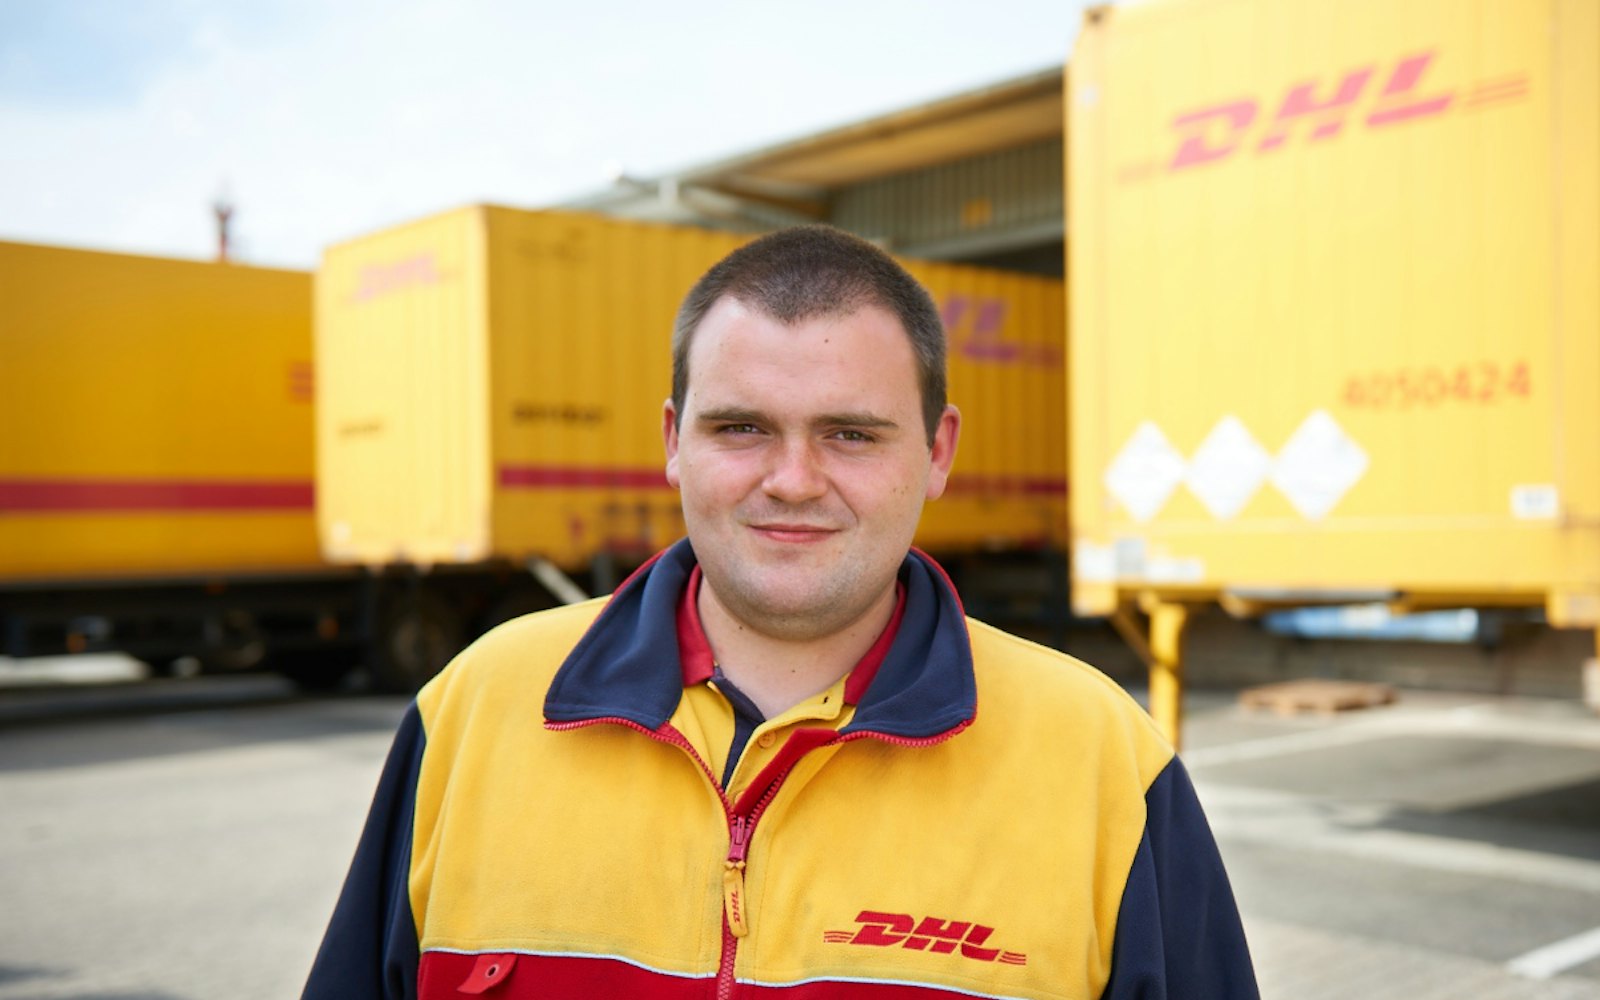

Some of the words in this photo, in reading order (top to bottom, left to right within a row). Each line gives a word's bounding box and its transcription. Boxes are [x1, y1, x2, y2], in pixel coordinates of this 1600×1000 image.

[1170, 50, 1455, 171] DHL
[731, 891, 741, 923] DHL
[849, 910, 1001, 962] DHL
